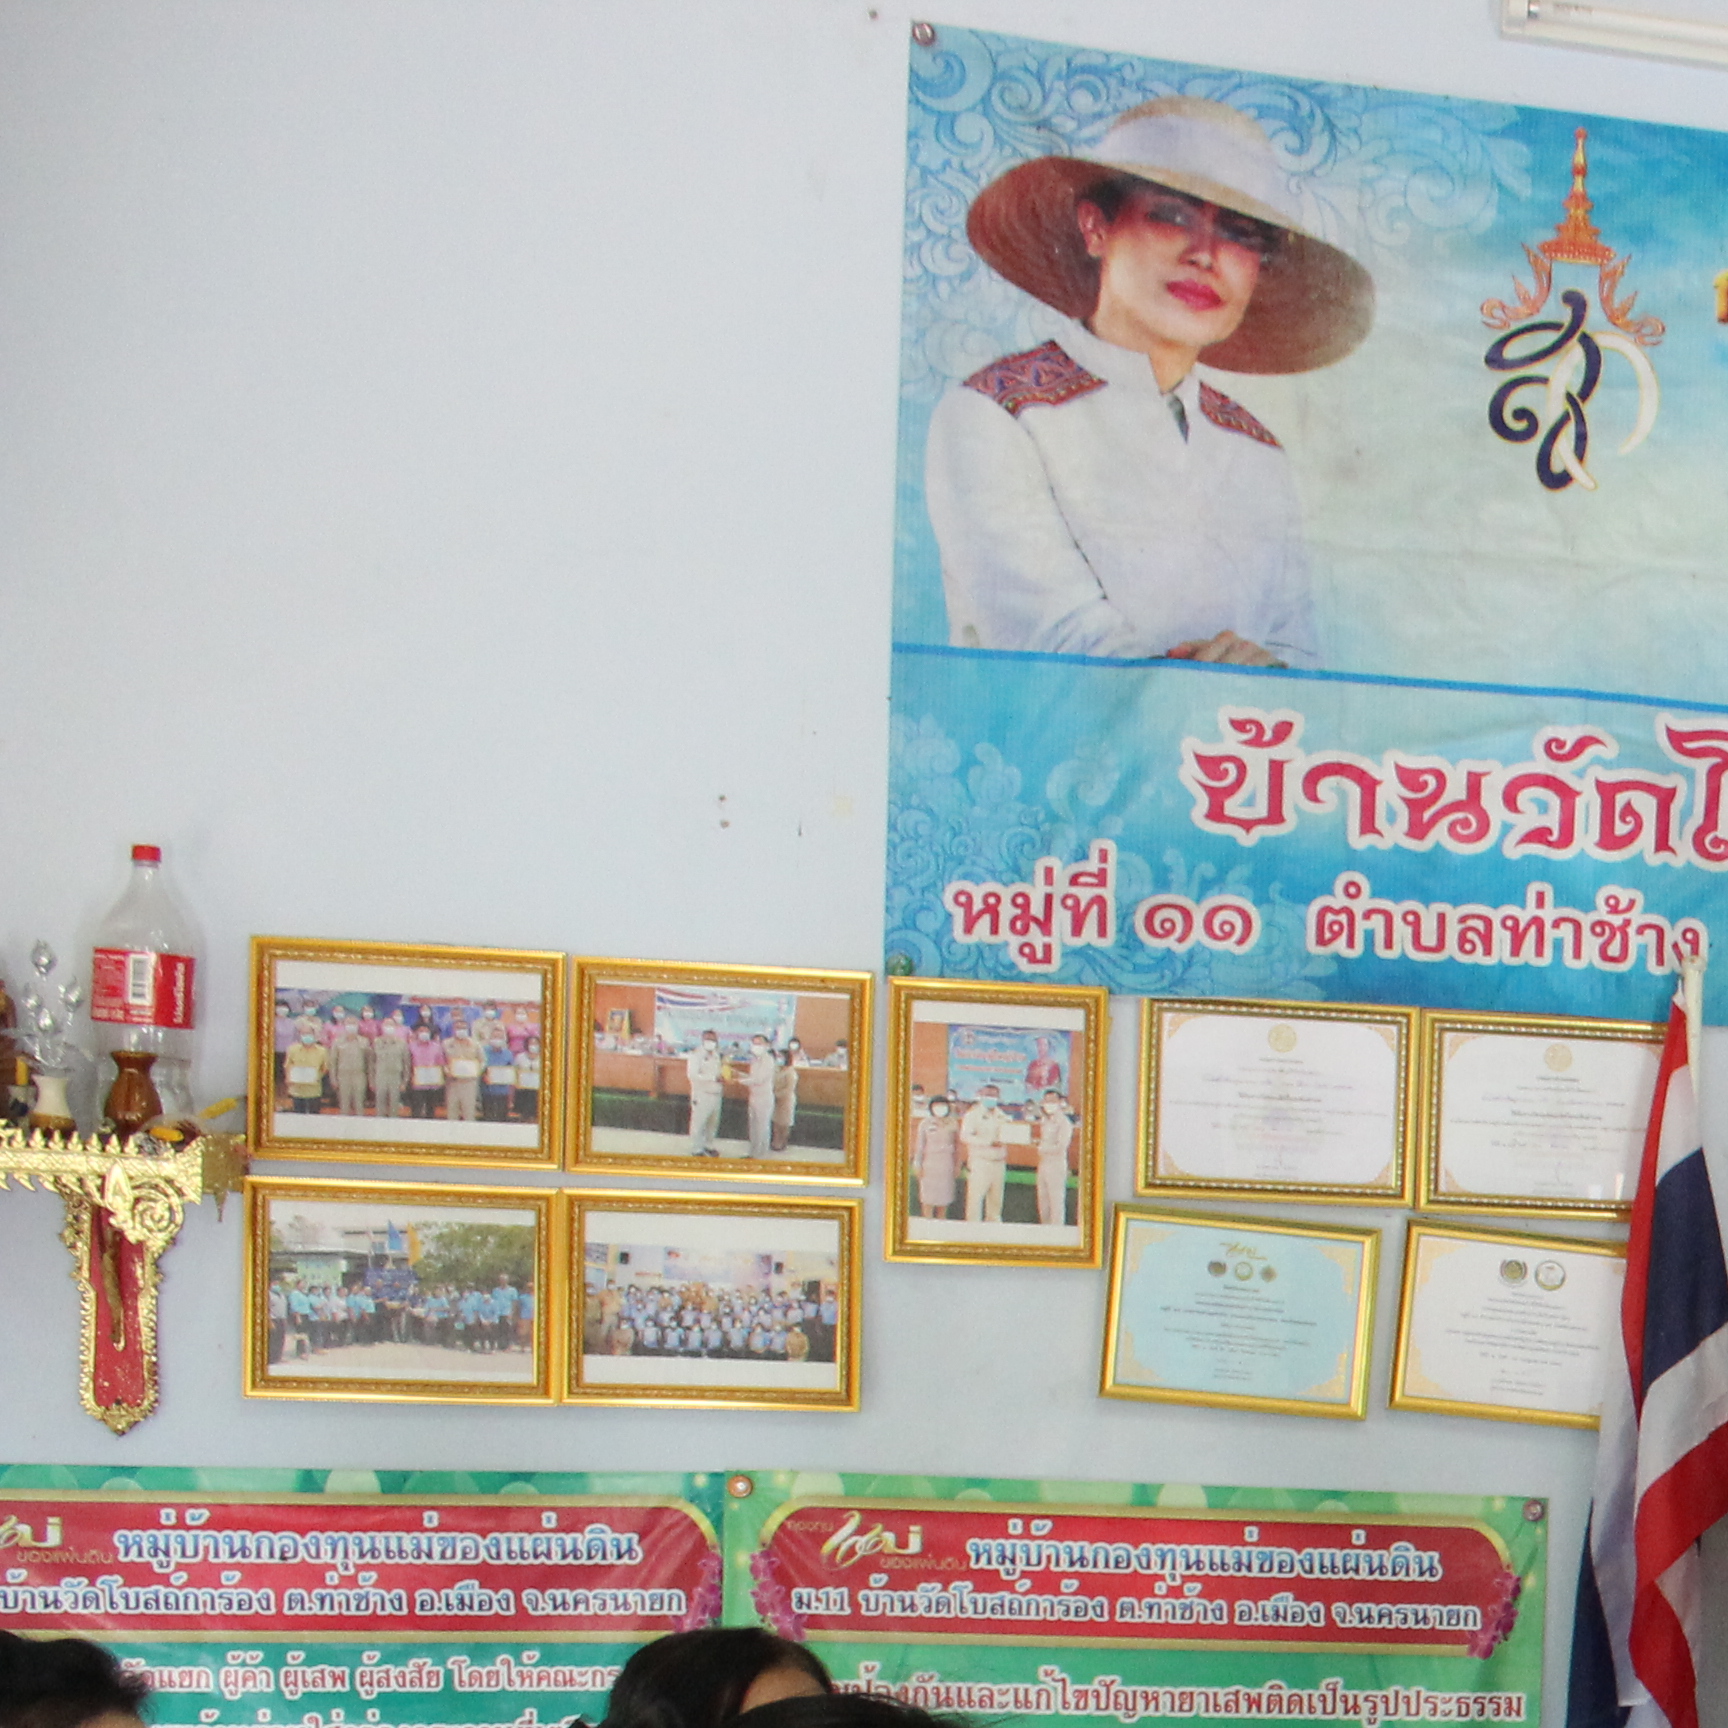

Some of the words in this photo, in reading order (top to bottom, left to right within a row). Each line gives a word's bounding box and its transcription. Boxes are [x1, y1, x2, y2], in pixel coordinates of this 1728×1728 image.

[952, 849, 1111, 966] หมู่ที่
[1144, 897, 1254, 950] ๑๑
[1316, 880, 1704, 970] ตำบลท่าช้าง
[116, 1509, 641, 1573] หมู่บ้านกองทุนแม่ของแผ่นดิน
[966, 1518, 1442, 1587] หมู่บ้านกองทุนแม่ของแผ่นดิน
[286, 1573, 408, 1616] ต.ท่าช้าง
[417, 1580, 515, 1616] อ.เมือง
[525, 1586, 687, 1616] จ.นครนายก
[790, 1588, 851, 1618] ม.11
[859, 1575, 1107, 1622] บ้านวัดโบสถ์การ้อง
[1116, 1584, 1230, 1628] ต.ท่าช้าง
[1237, 1594, 1325, 1629] อ.เมือง
[1333, 1600, 1482, 1632] จ.นครนายก
[221, 1652, 274, 1695] ผู้ค้า
[280, 1652, 349, 1695] ผู้เสพ
[356, 1652, 443, 1695] ผู้สงสัย
[450, 1652, 622, 1692] โดยให้คณะกร
